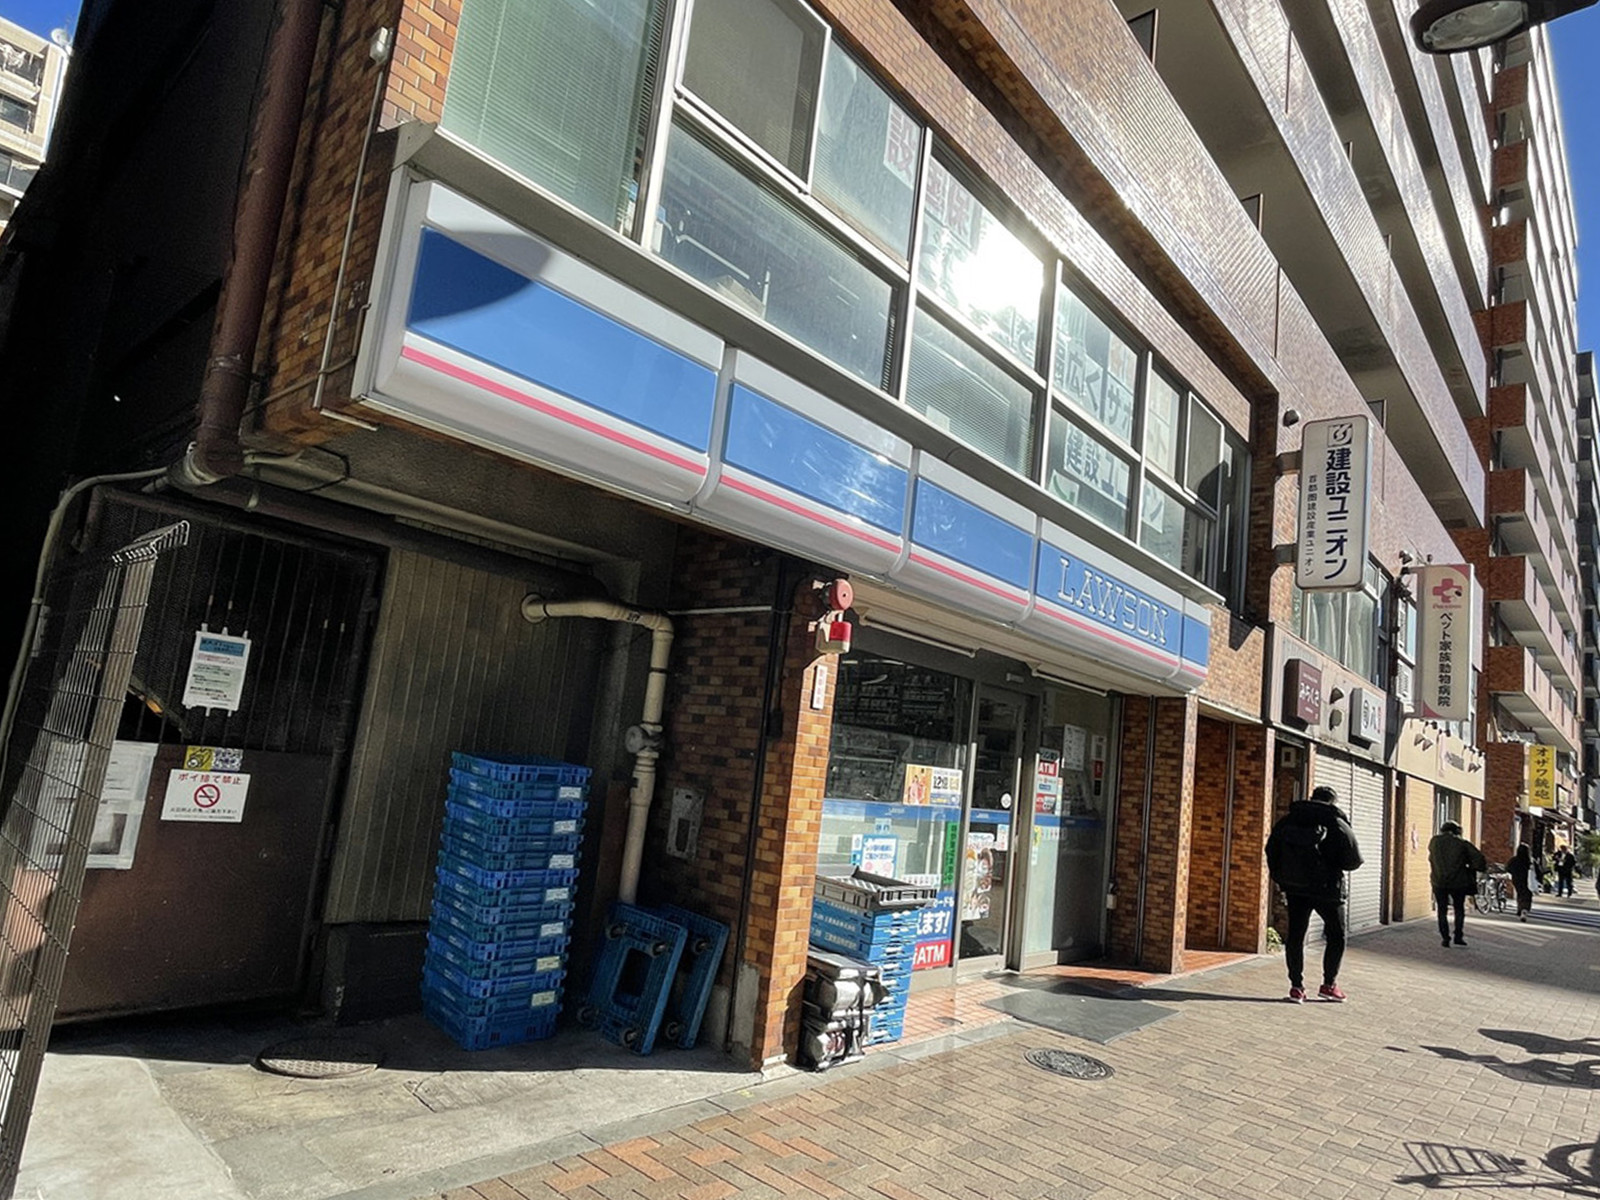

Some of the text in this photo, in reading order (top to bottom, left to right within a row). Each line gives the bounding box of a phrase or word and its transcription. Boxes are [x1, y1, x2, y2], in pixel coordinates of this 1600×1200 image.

[1324, 447, 1352, 580] 建設ユニオン
[1057, 556, 1169, 646] LAWSON
[1437, 611, 1453, 708] ペット家族動物病院
[178, 773, 242, 785] ポイ捨て禁止
[1039, 762, 1055, 775] ATM
